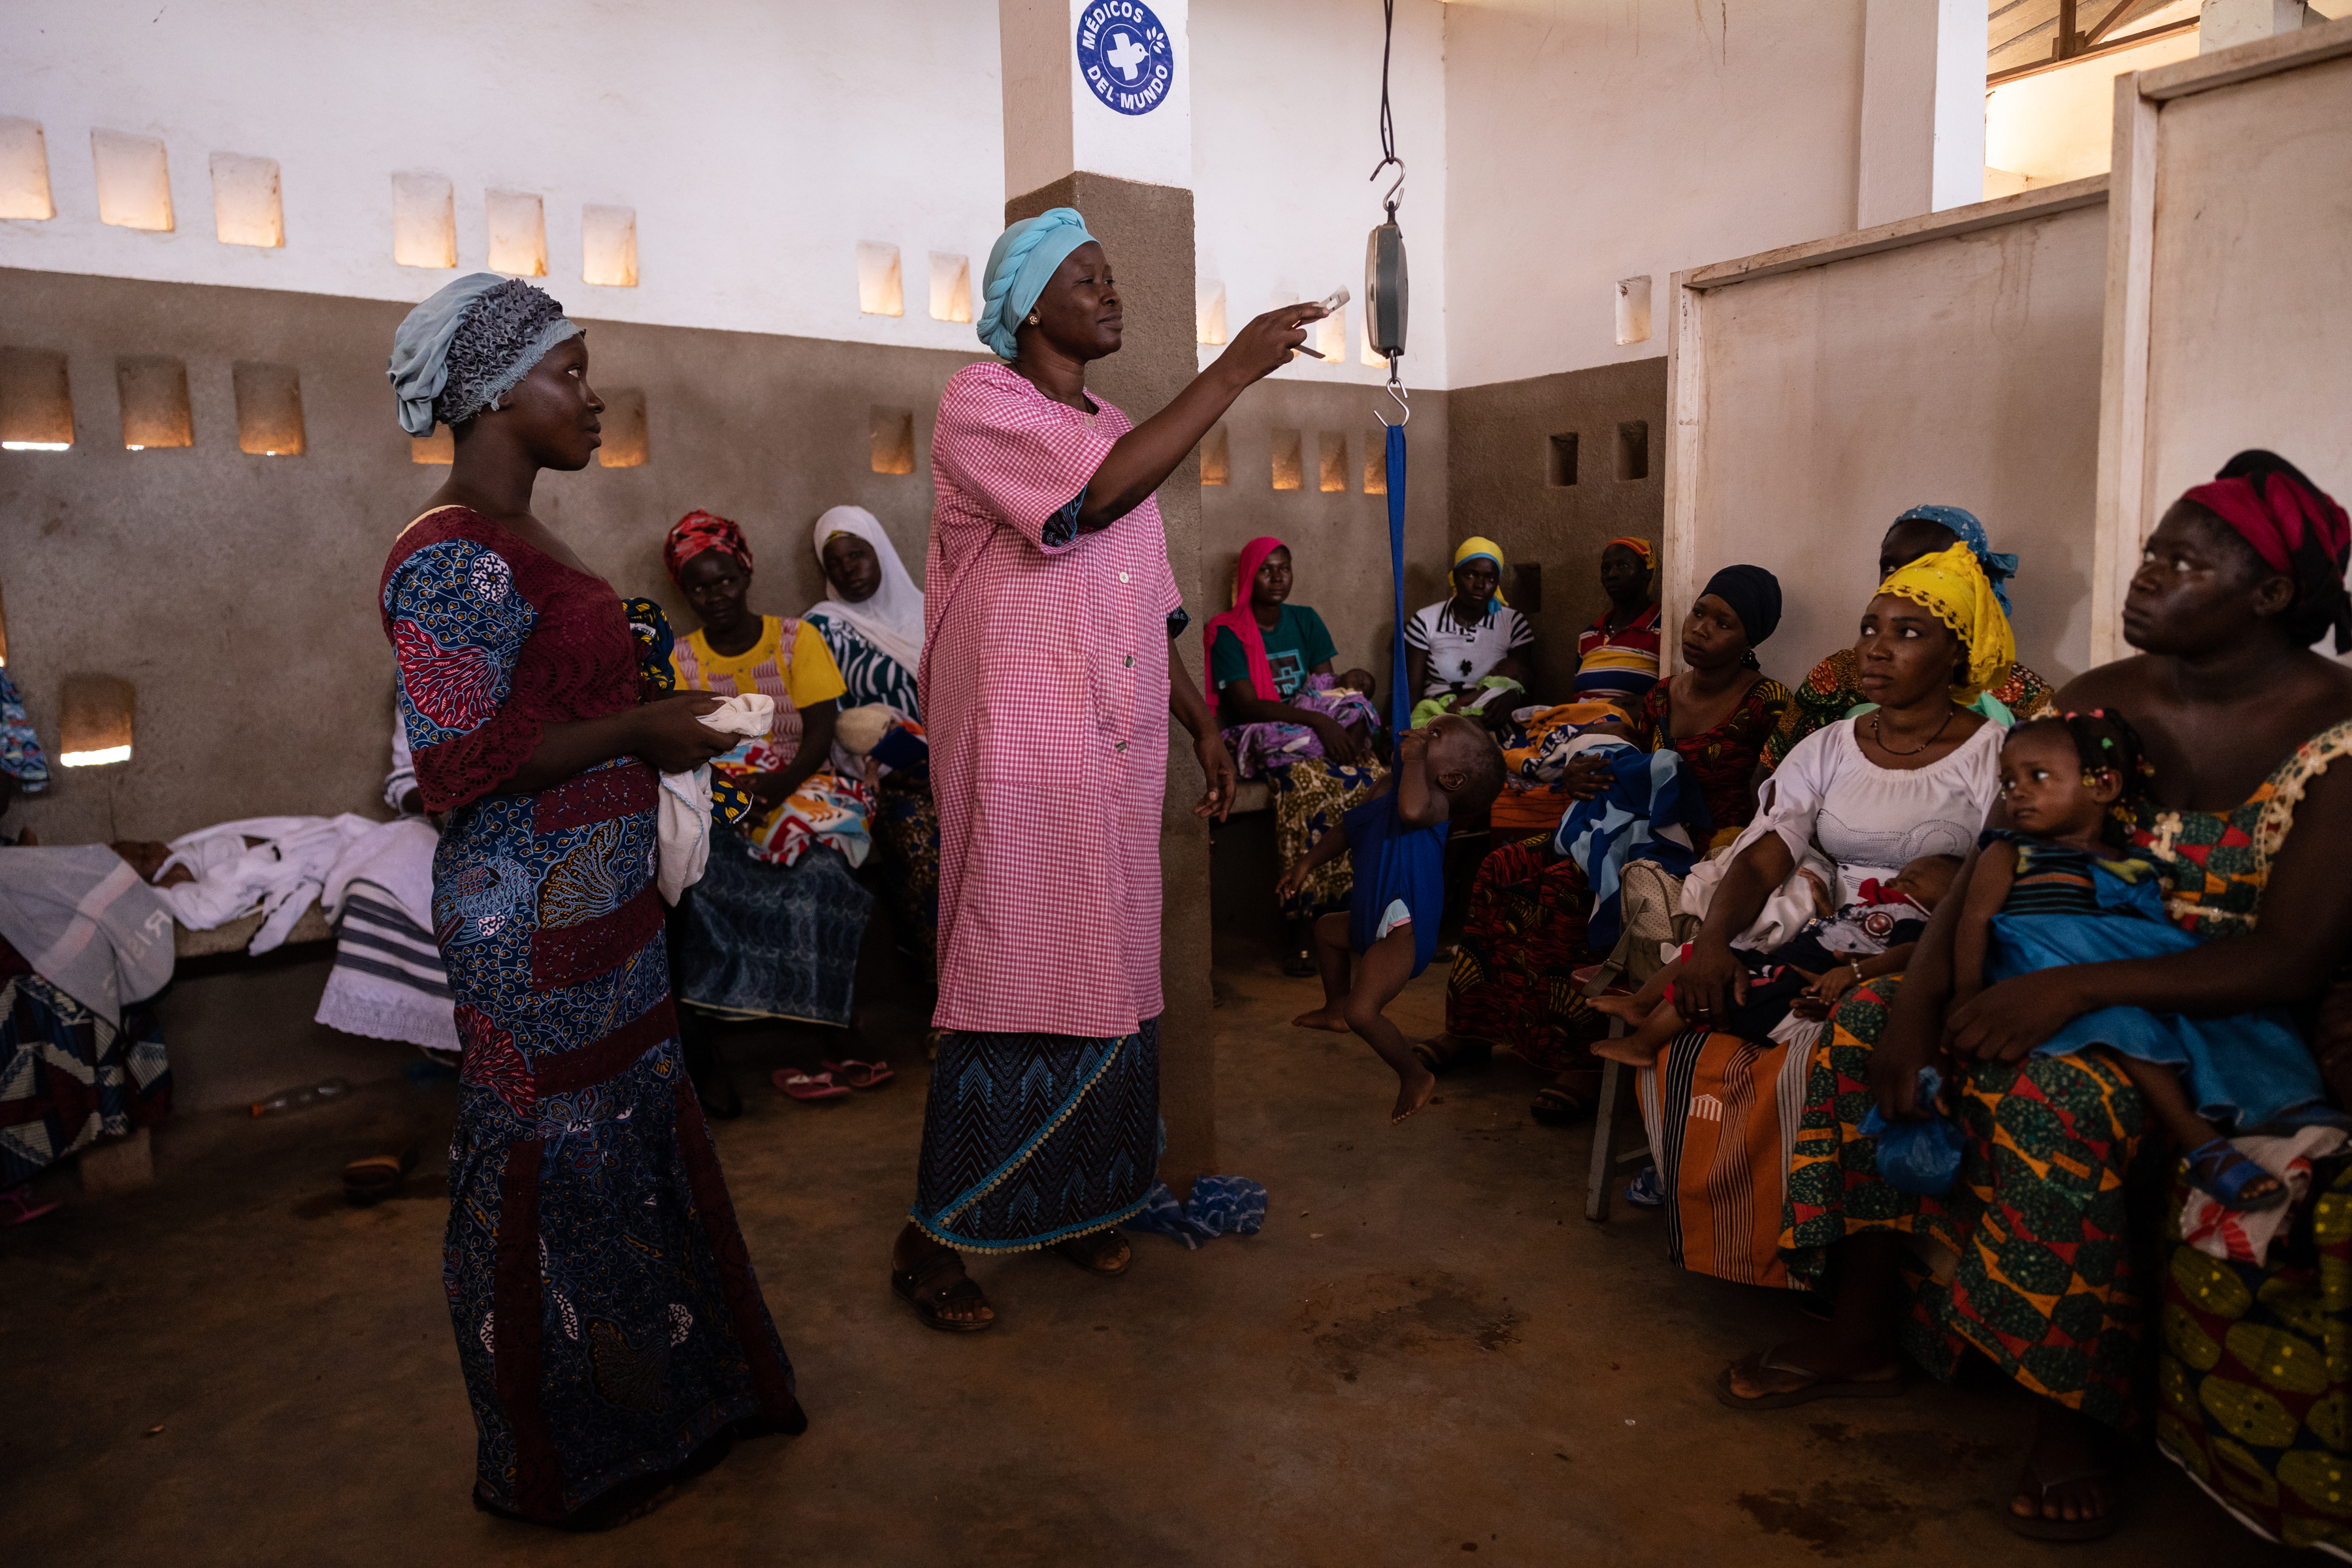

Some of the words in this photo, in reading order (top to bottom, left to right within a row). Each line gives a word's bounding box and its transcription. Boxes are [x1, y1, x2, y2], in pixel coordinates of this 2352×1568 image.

[1082, 1, 1143, 50] MÉDICOS
[1087, 65, 1114, 102] DEL
[1120, 65, 1168, 109] MUNDO
